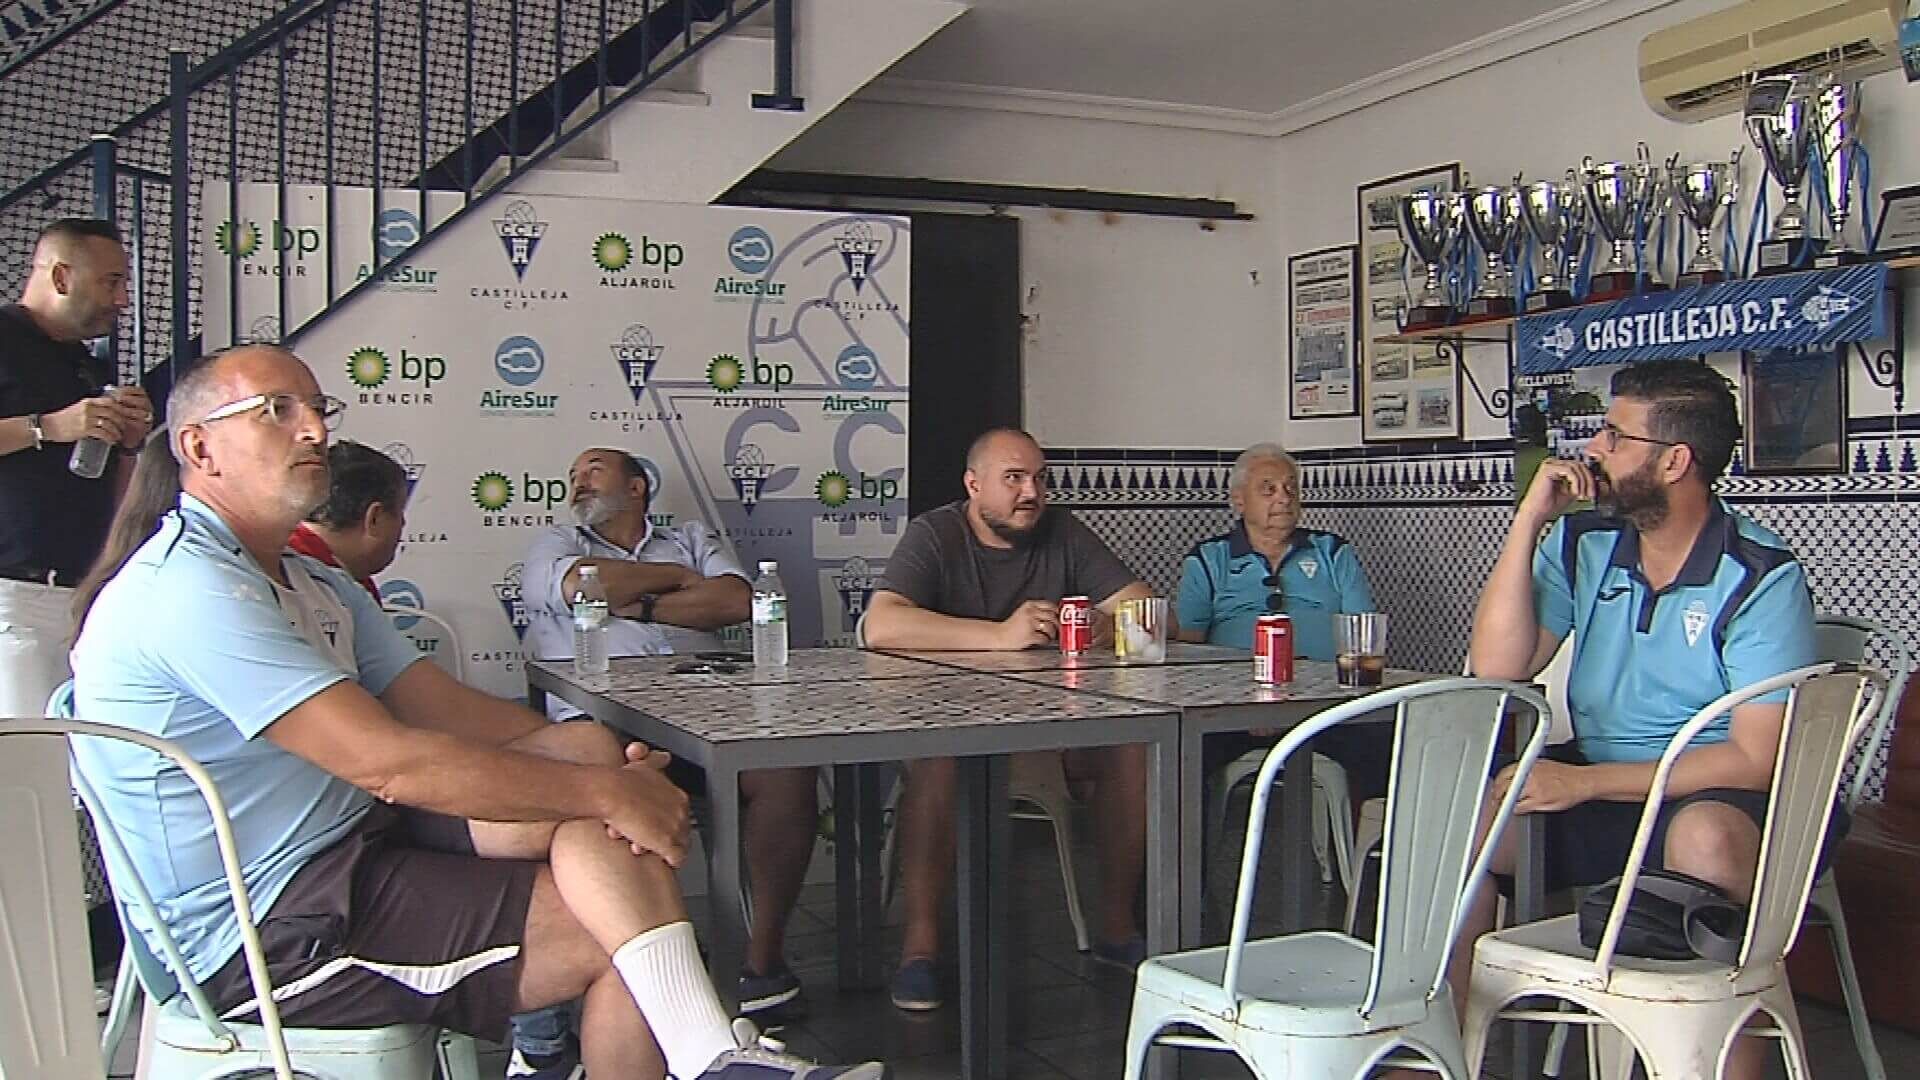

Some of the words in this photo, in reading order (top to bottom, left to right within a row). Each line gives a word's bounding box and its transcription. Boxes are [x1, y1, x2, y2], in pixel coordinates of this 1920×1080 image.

[273, 220, 319, 260] bp
[642, 236, 684, 272] bp
[600, 277, 675, 289] ALJAROIL
[714, 277, 786, 295] AireSur
[471, 287, 568, 299] CASTILLEJA
[1584, 303, 1736, 352] CASTILLEJA
[1741, 297, 1792, 334] C.F.
[402, 350, 445, 387] bp
[753, 358, 793, 391] bp
[360, 393, 432, 405] BENCIR
[480, 390, 559, 409] AireSur
[713, 398, 786, 409] ALJAROIL
[823, 394, 891, 412] AireSur
[524, 472, 567, 510] bp
[860, 472, 898, 506] bp
[484, 515, 553, 527] BENCIR
[822, 511, 891, 522] ALJAROIL
